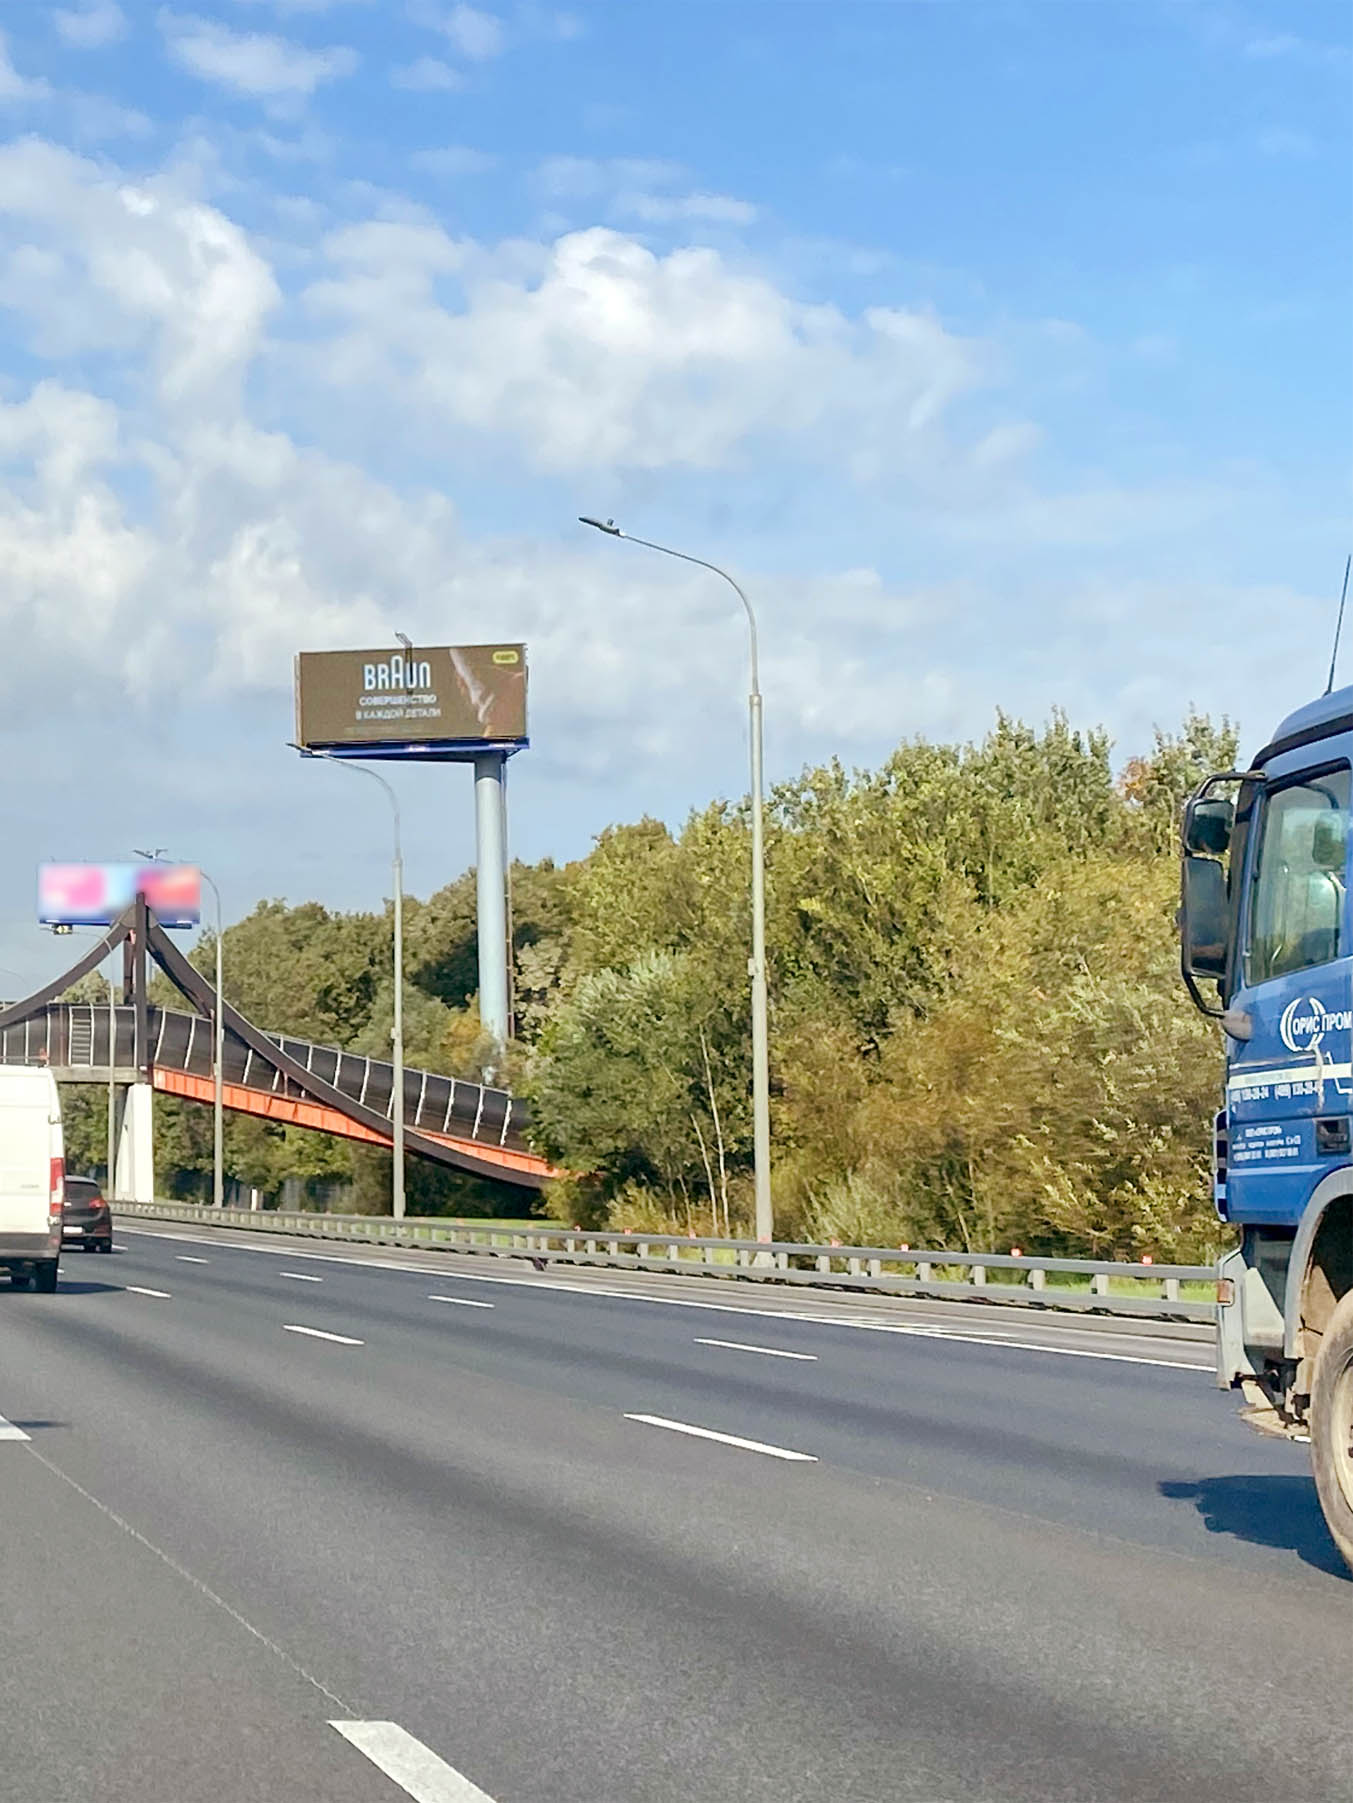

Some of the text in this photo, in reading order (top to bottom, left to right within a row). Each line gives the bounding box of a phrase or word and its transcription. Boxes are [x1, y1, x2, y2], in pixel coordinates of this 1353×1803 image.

[363, 654, 431, 691] BRAUN
[359, 694, 437, 706] СОВЕРШЕНСТВО
[1292, 1010, 1353, 1036] ОРИС ПРОМ
